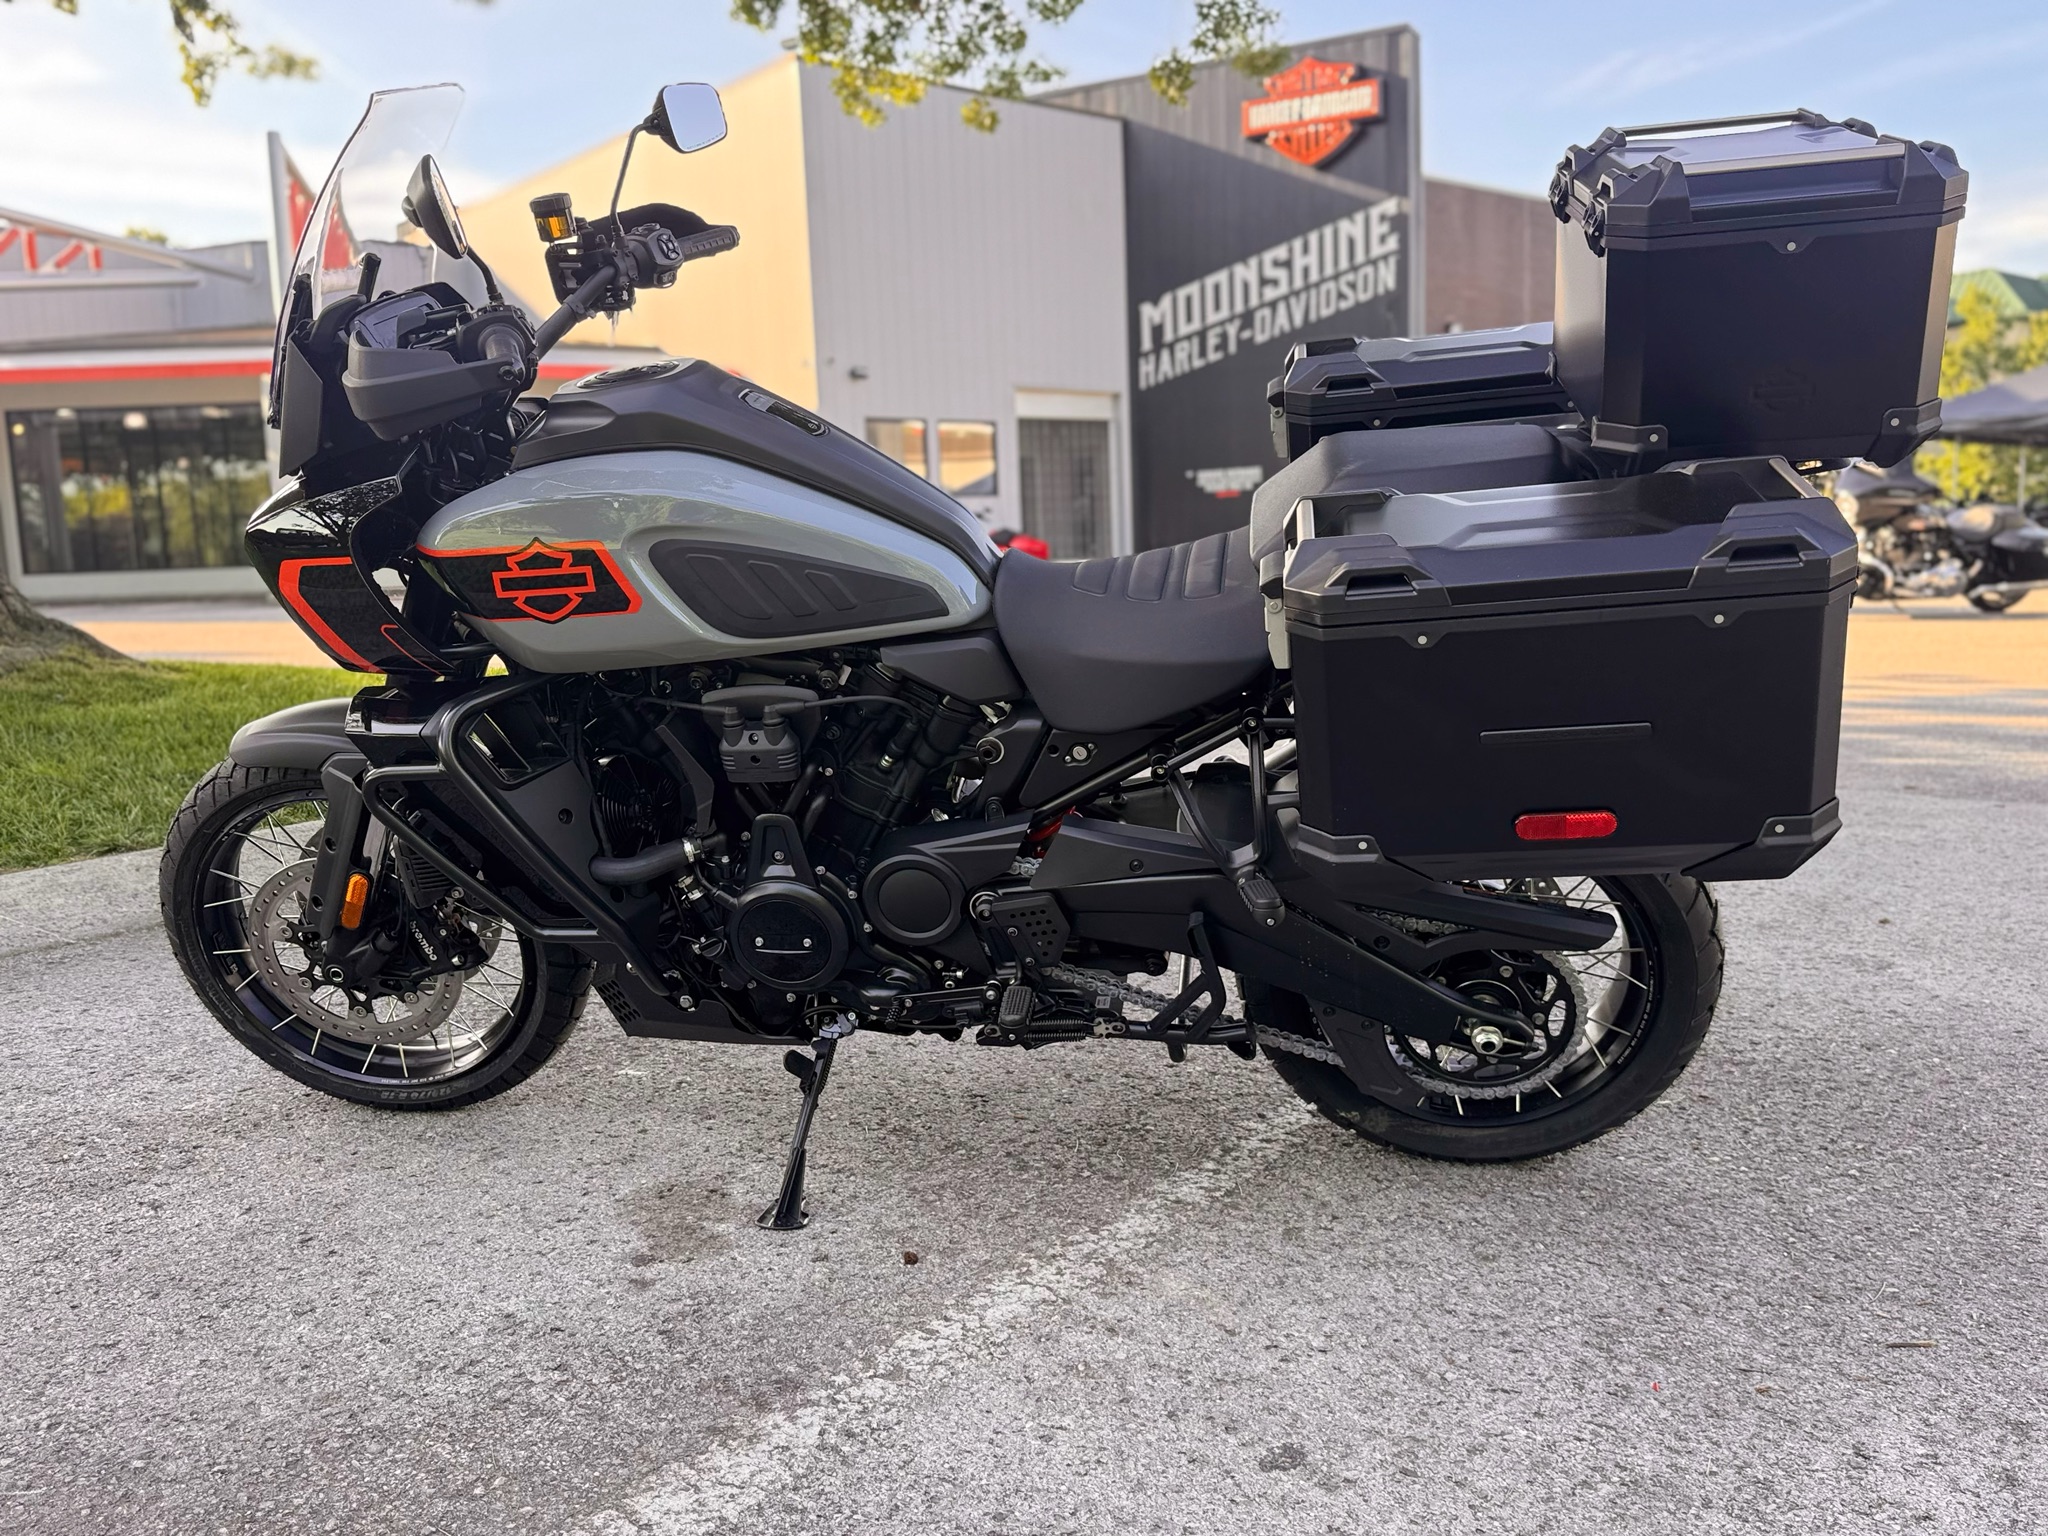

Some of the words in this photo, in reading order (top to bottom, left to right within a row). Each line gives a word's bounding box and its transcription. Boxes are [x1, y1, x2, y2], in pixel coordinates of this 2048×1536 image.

[1138, 254, 1398, 391] HARLEY-DAVIDSON
[1139, 195, 1400, 354] MOONSHINE
[410, 920, 437, 961] brembo
